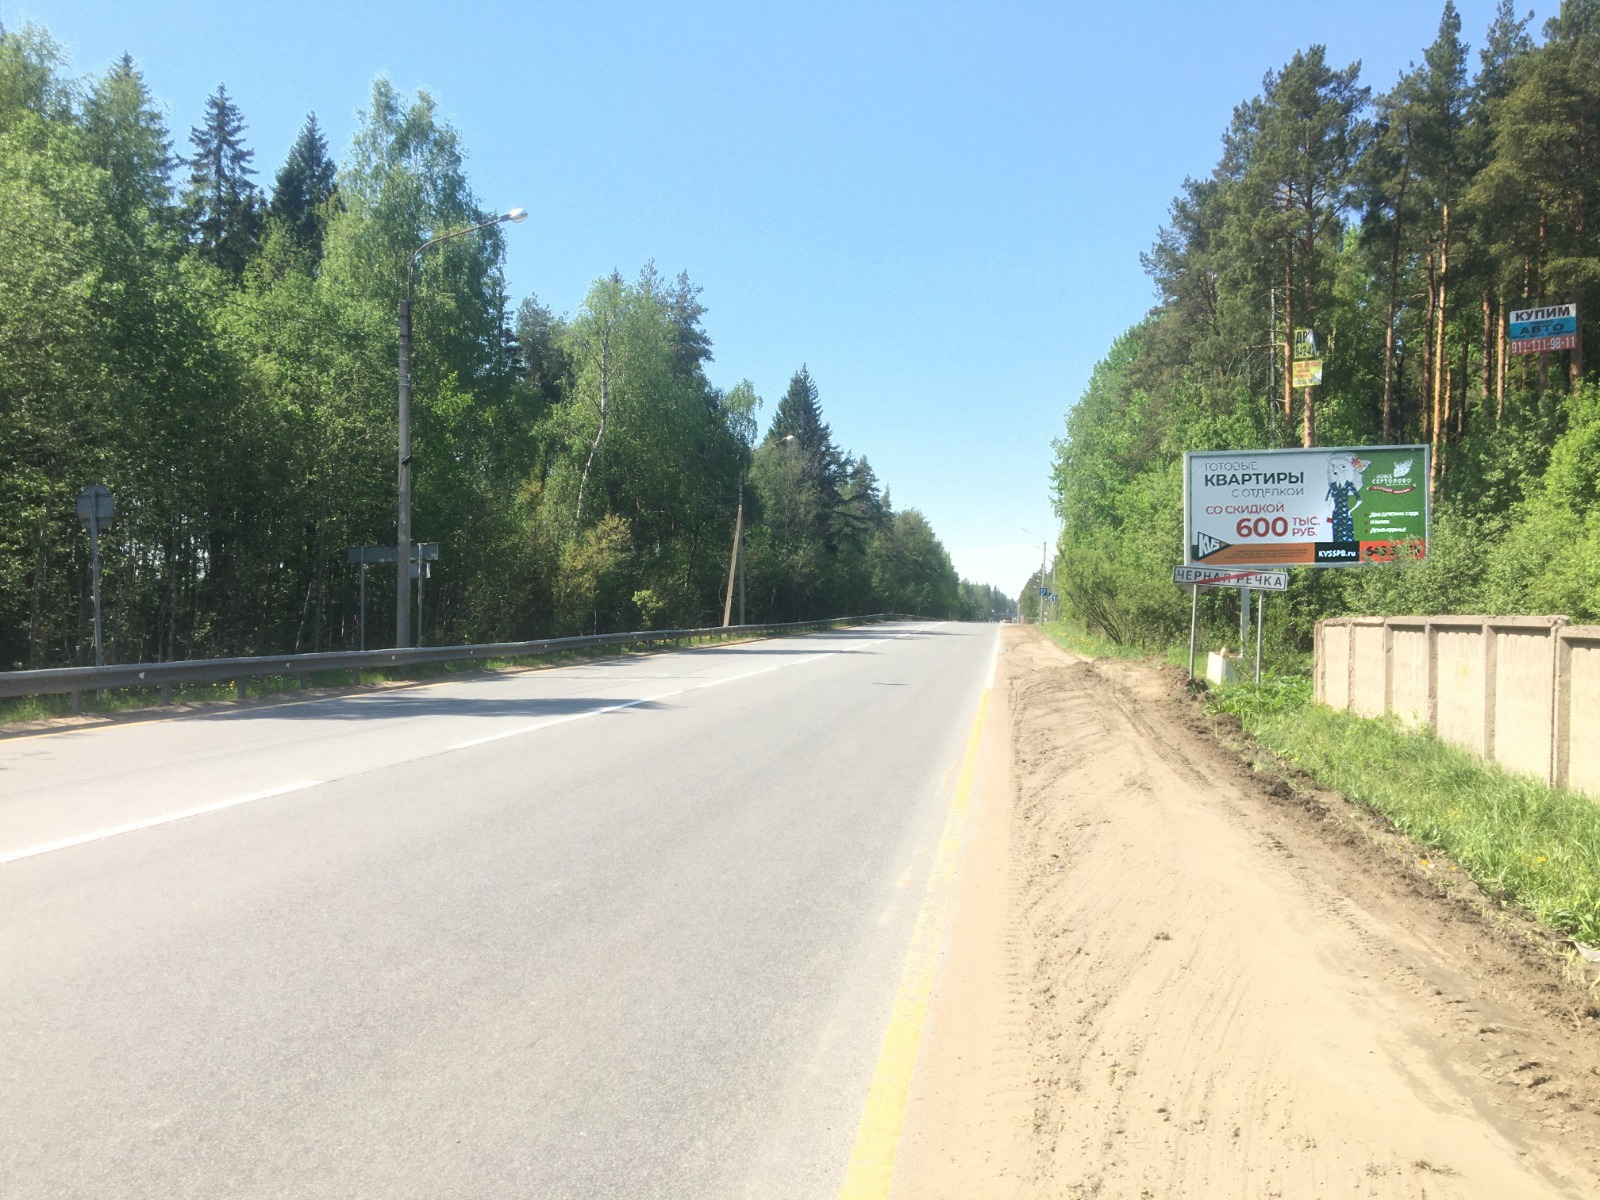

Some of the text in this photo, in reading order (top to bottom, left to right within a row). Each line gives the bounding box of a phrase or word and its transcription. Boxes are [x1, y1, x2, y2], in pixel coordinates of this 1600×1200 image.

[1515, 306, 1570, 322] КУПИМ
[1520, 323, 1564, 334] АВТО
[1296, 330, 1310, 346] ДР
[1511, 336, 1575, 354] 911-111-98-11
[1205, 461, 1258, 472] ГОТОВЫЕ
[1204, 471, 1304, 487] КВАРТИРЫ
[1231, 486, 1304, 498] С ОТДЕЛКОЙ
[1205, 502, 1285, 515] СО СКИДКОЙ
[1236, 516, 1289, 538] 600
[1291, 516, 1321, 526] ТЫС.
[1292, 527, 1318, 537] РУБ.
[1177, 569, 1282, 587] ЧЕРНАЯ РЕЧКА
